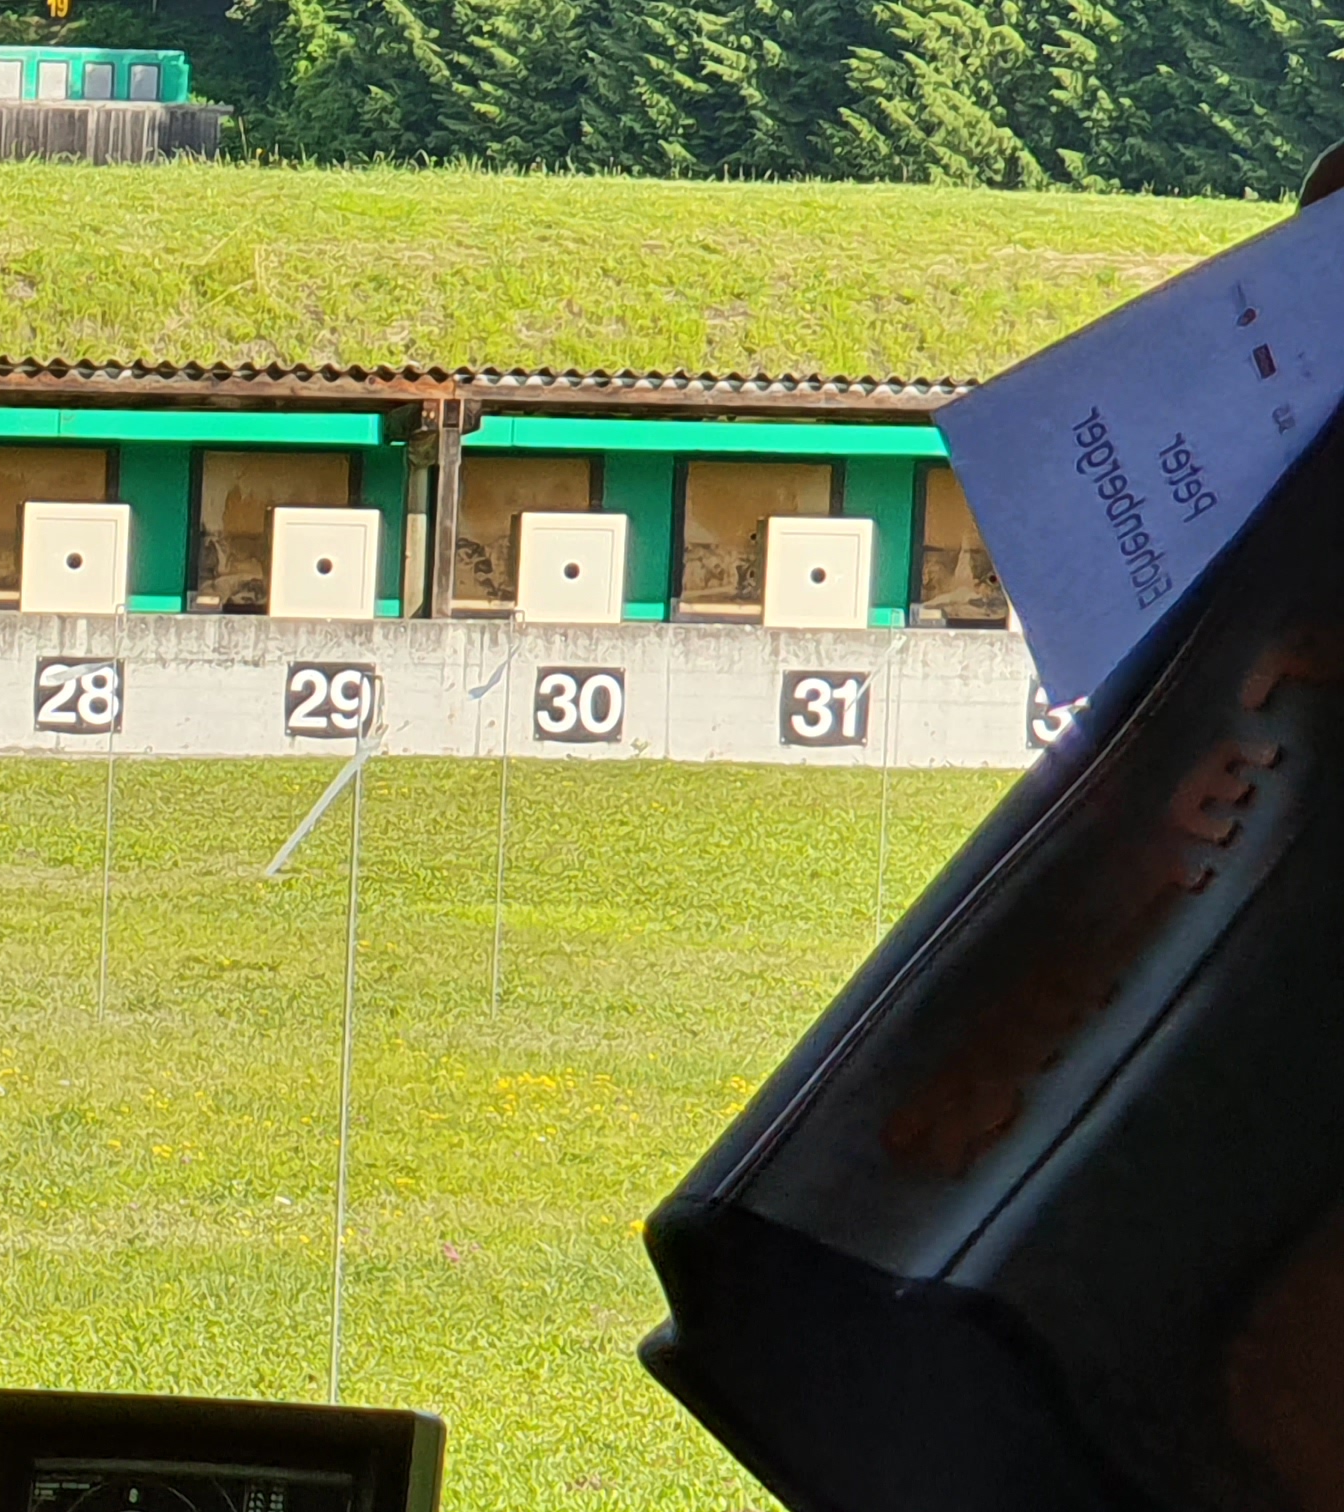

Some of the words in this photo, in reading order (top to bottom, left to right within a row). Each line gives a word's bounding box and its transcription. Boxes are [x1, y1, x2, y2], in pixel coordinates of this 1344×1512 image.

[47, 0, 69, 18] 19
[37, 662, 119, 723] 28
[288, 668, 371, 731] 29
[537, 673, 624, 736] 30
[791, 677, 859, 738] 31
